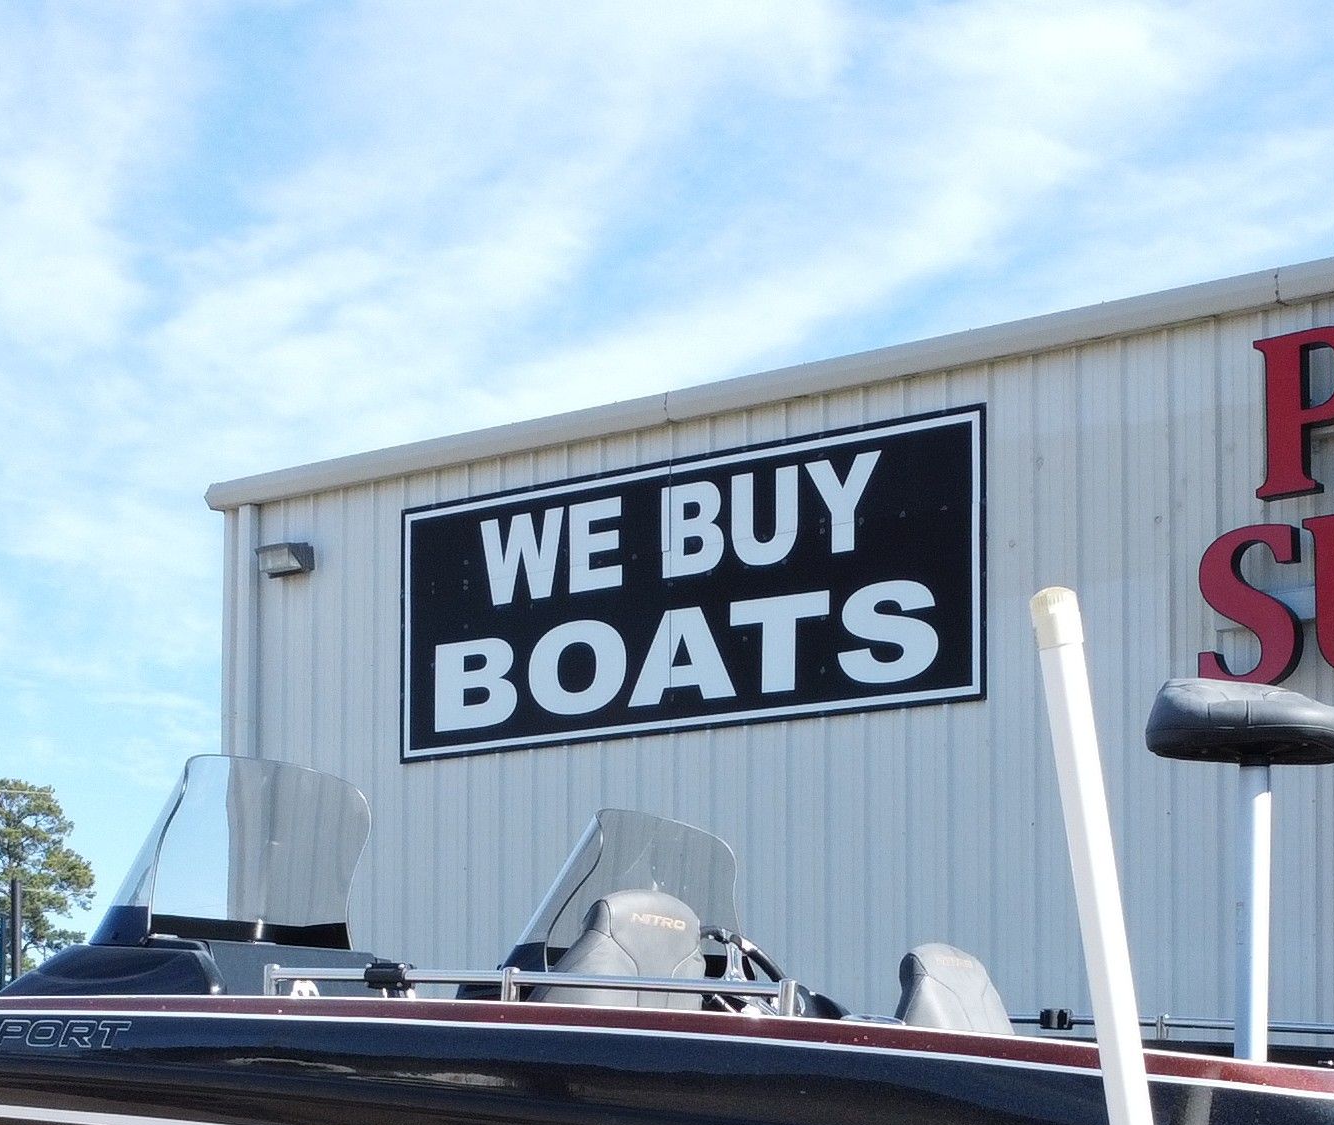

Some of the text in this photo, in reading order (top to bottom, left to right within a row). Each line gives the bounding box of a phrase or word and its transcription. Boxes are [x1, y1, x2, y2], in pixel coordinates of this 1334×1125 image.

[480, 450, 881, 606] WE BUY
[434, 580, 939, 733] BOATS
